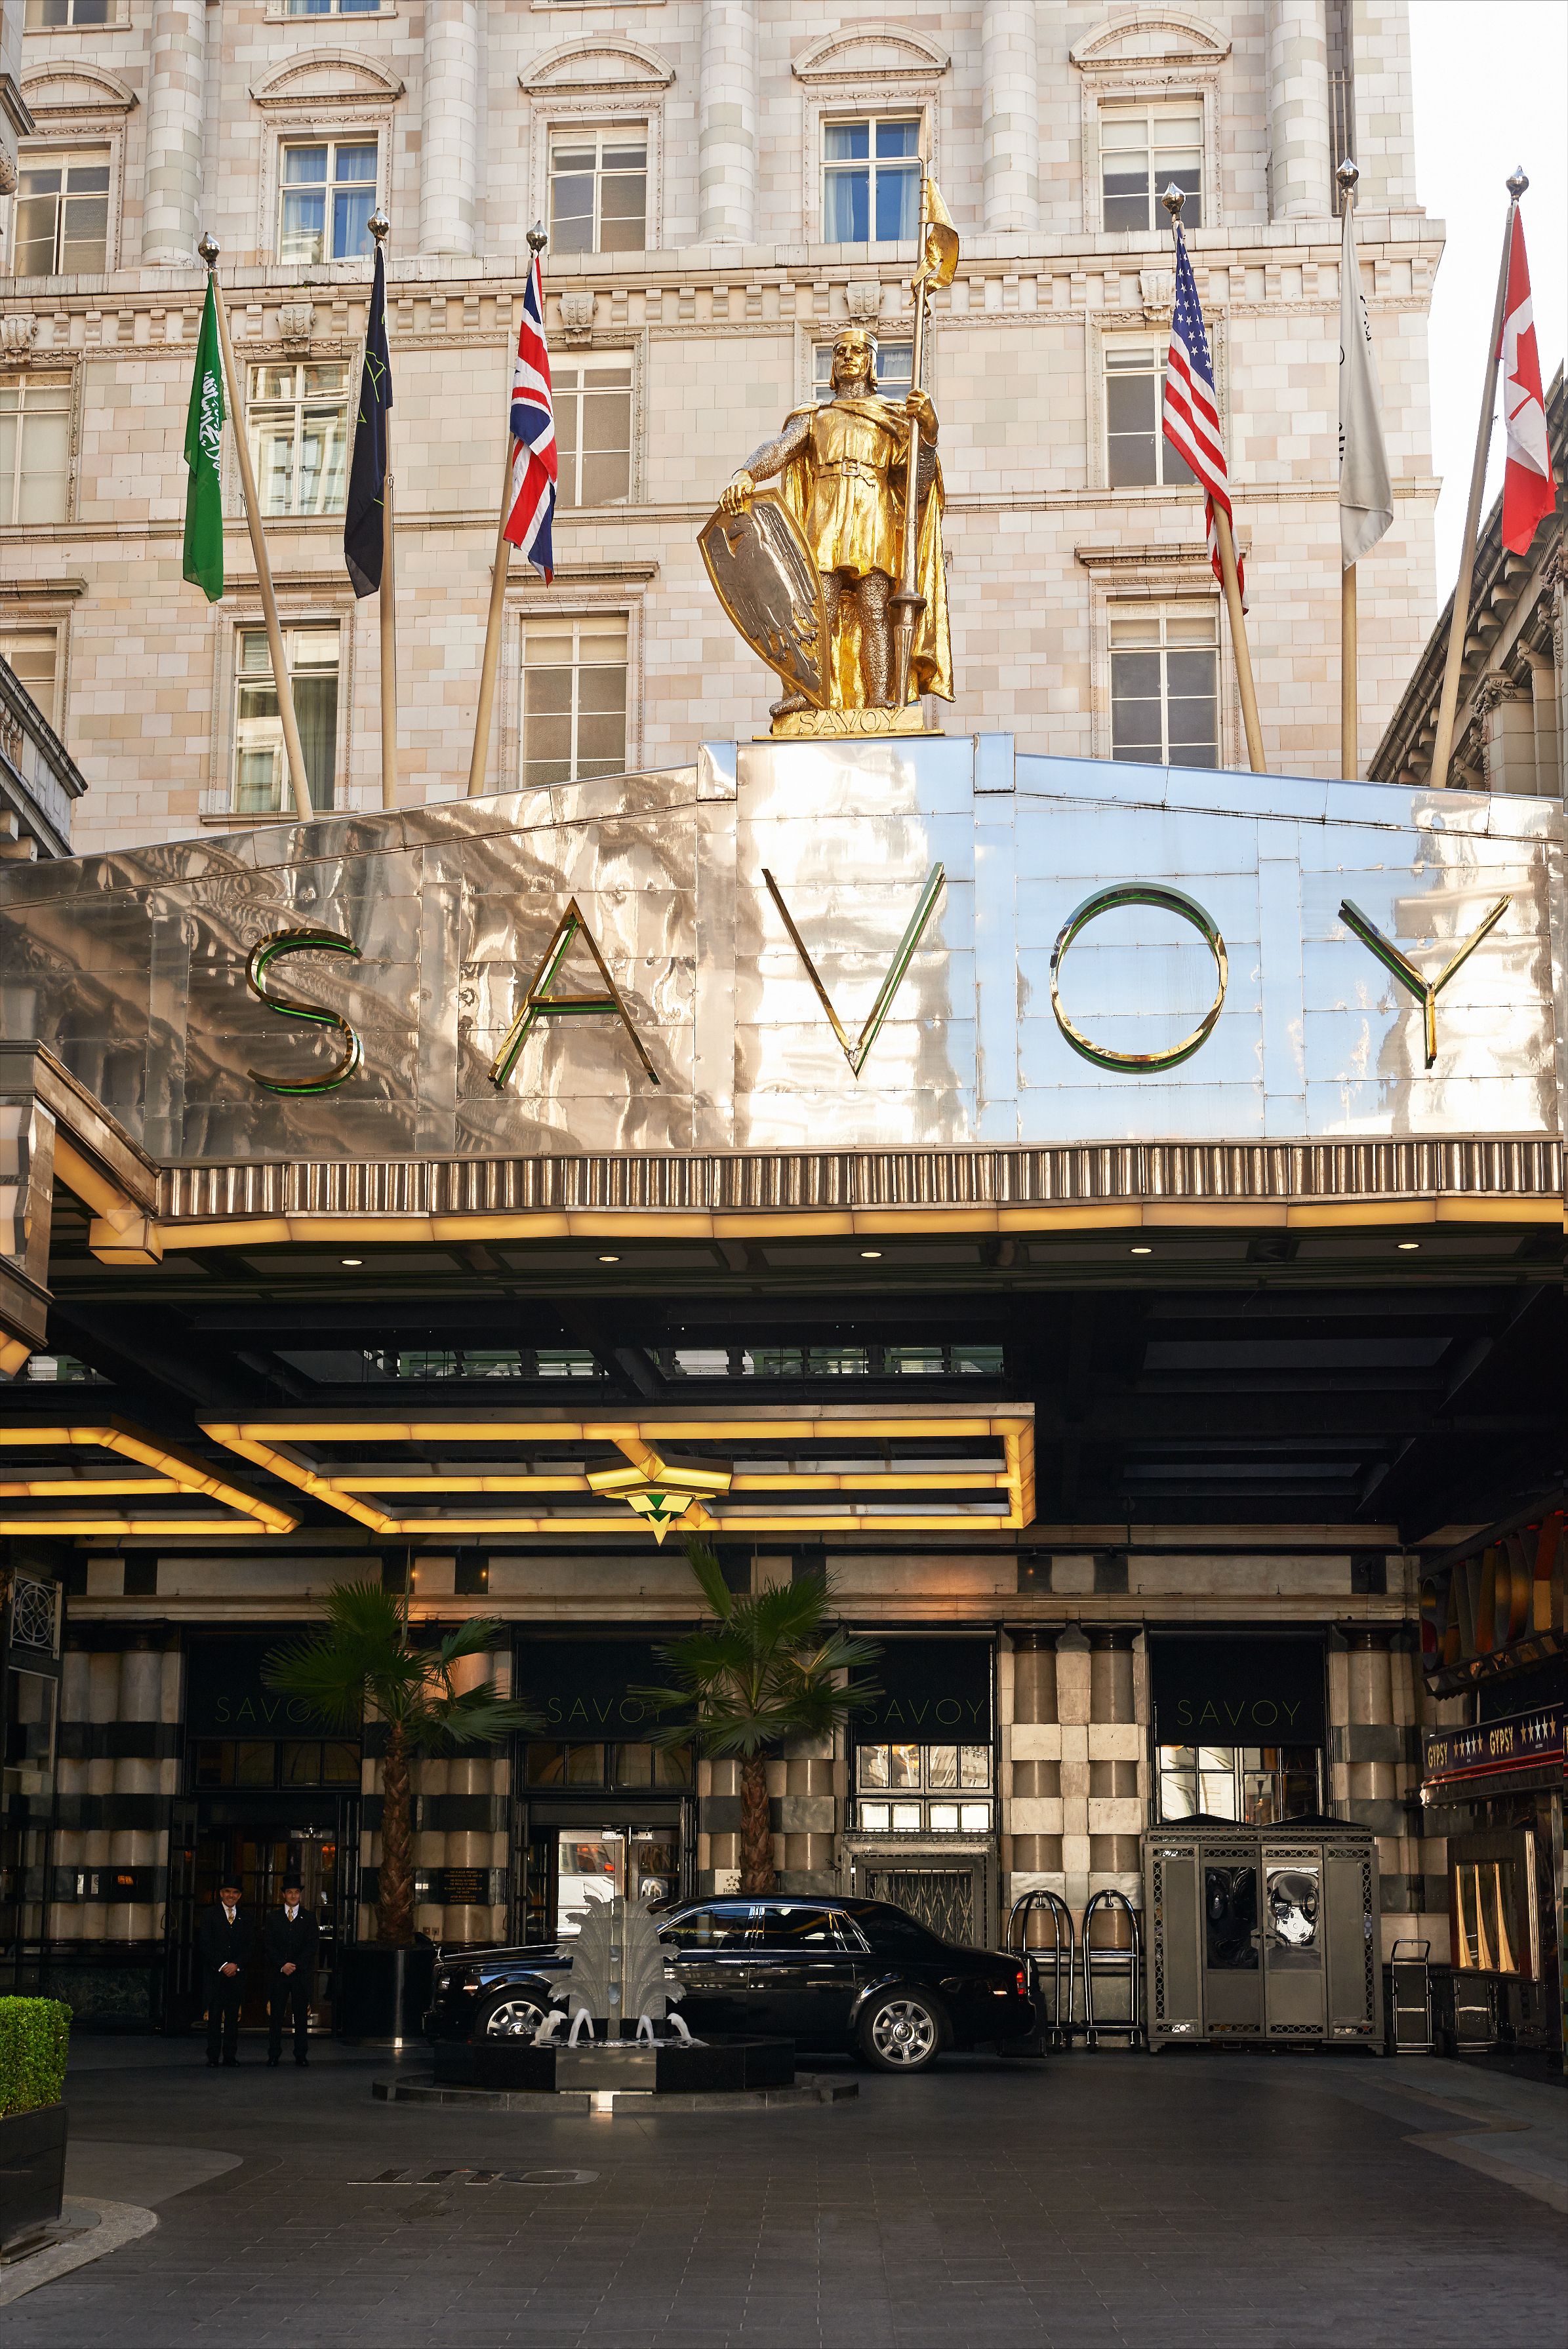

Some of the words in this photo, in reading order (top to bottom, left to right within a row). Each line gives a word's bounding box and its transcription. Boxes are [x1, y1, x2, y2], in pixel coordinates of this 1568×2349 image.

[798, 708, 905, 735] SAVOY
[245, 862, 1514, 1094] SAVOY
[861, 1698, 984, 1725] SAVOY
[1176, 1699, 1301, 1727] SAVOY
[1427, 1742, 1448, 1769] GYPSY
[1489, 1725, 1514, 1757] GYPSY
[346, 2168, 602, 2186] OUT
